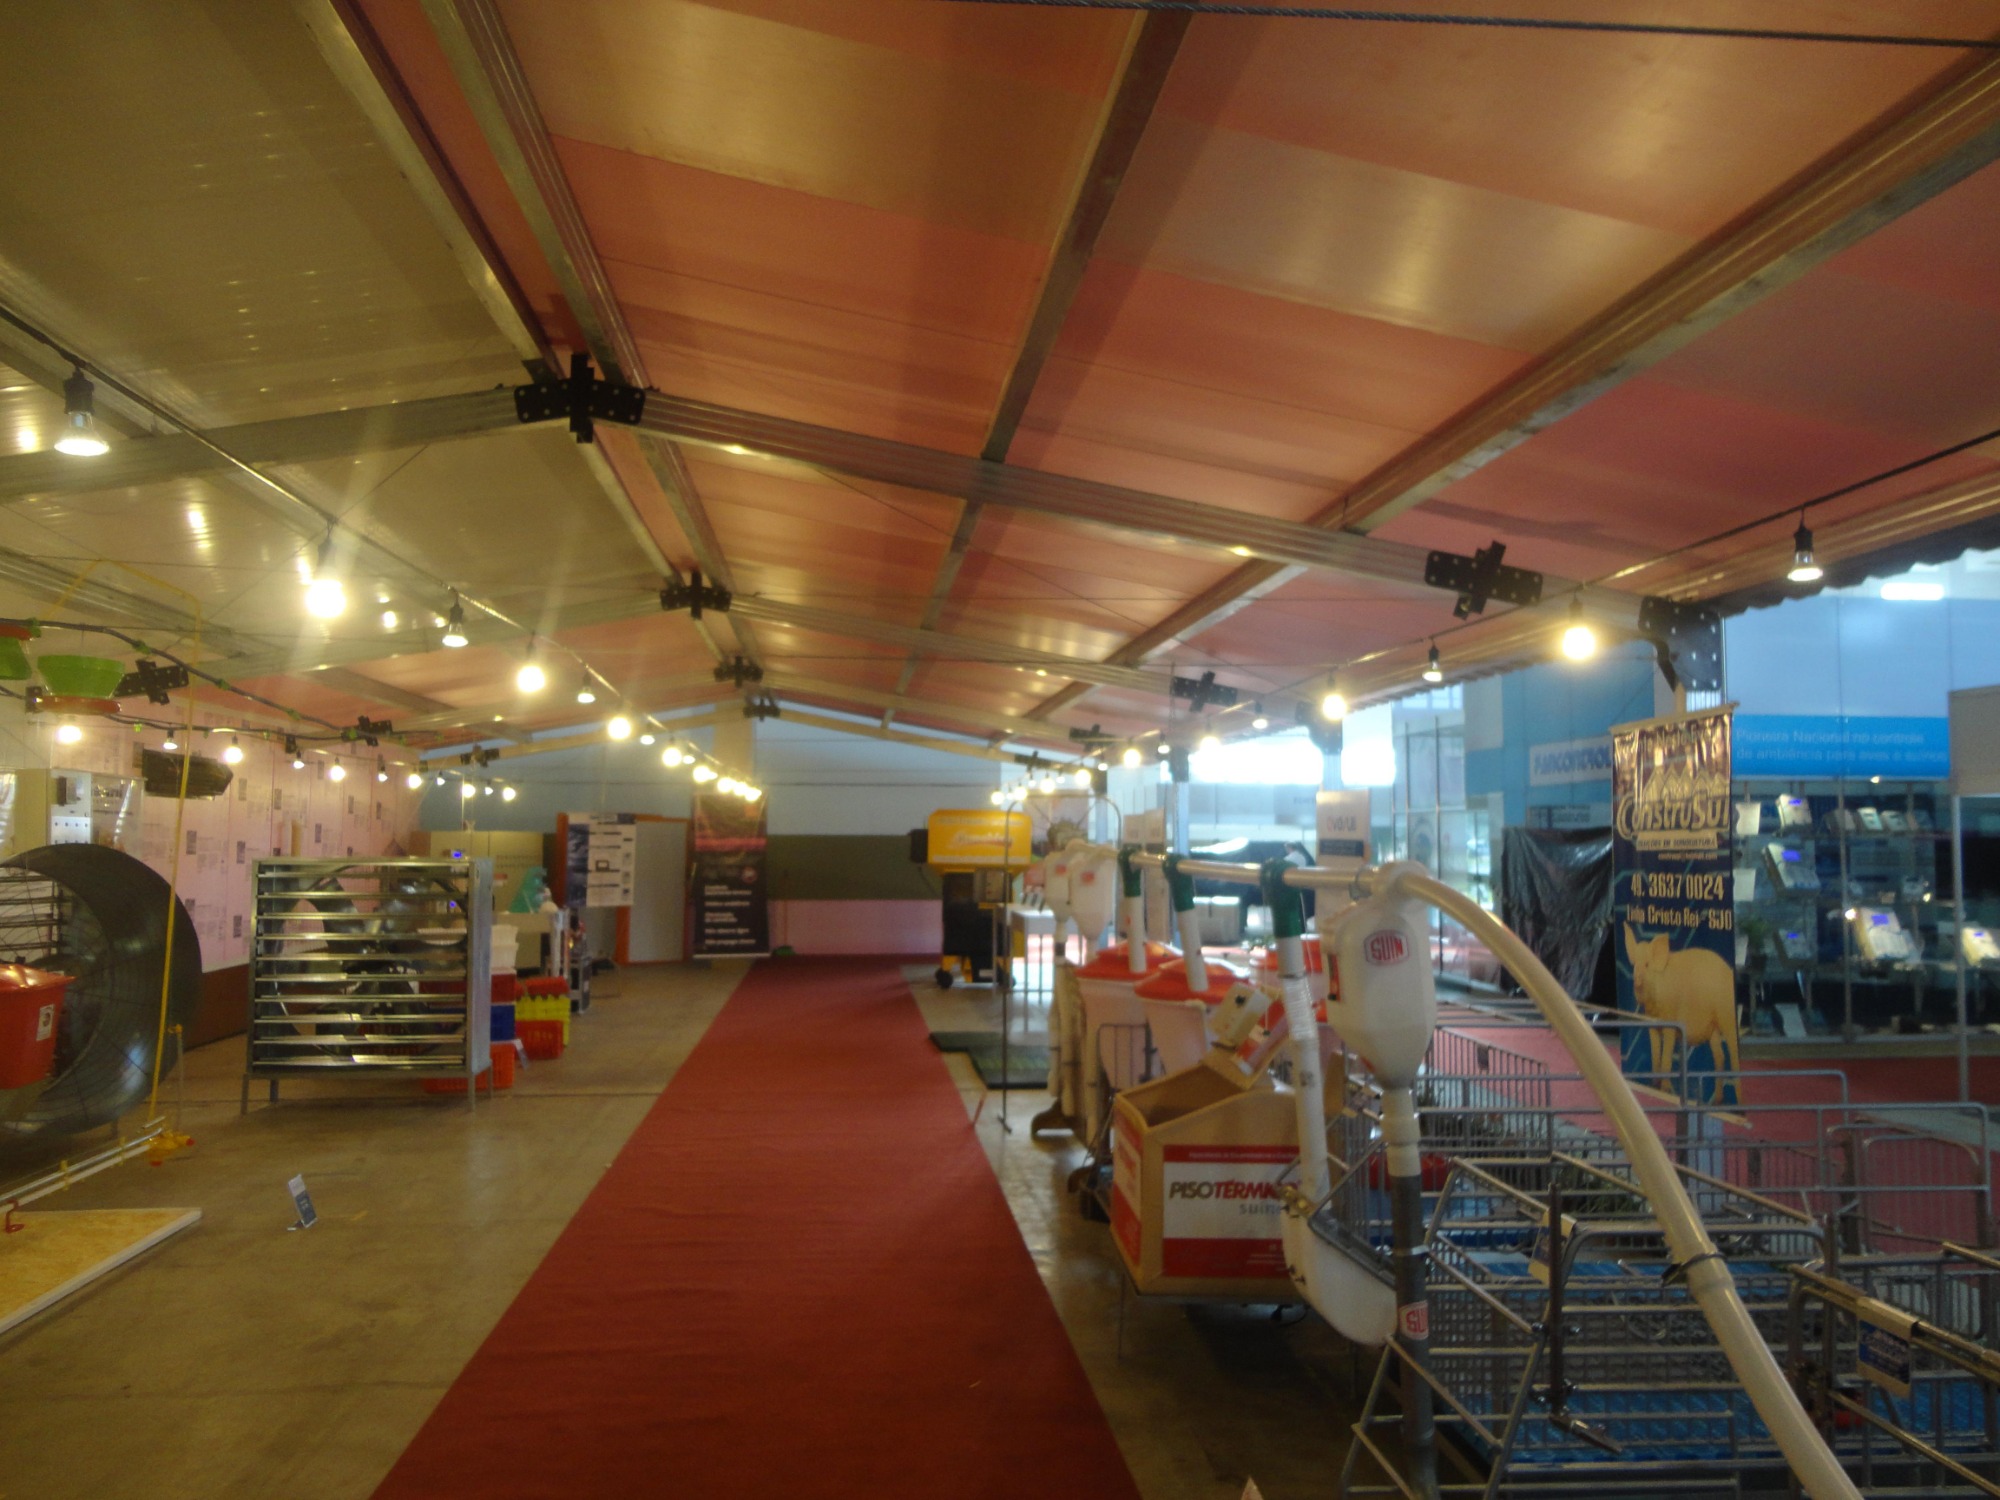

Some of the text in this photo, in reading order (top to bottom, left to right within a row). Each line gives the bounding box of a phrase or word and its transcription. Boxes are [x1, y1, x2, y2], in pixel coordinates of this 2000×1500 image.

[1794, 731, 1850, 744] Nacional
[1648, 873, 1682, 898] 3637
[1686, 873, 1724, 900] 0024
[1648, 904, 1681, 926] Cristo
[1684, 907, 1699, 928] Rei
[1370, 936, 1404, 961] SUIN
